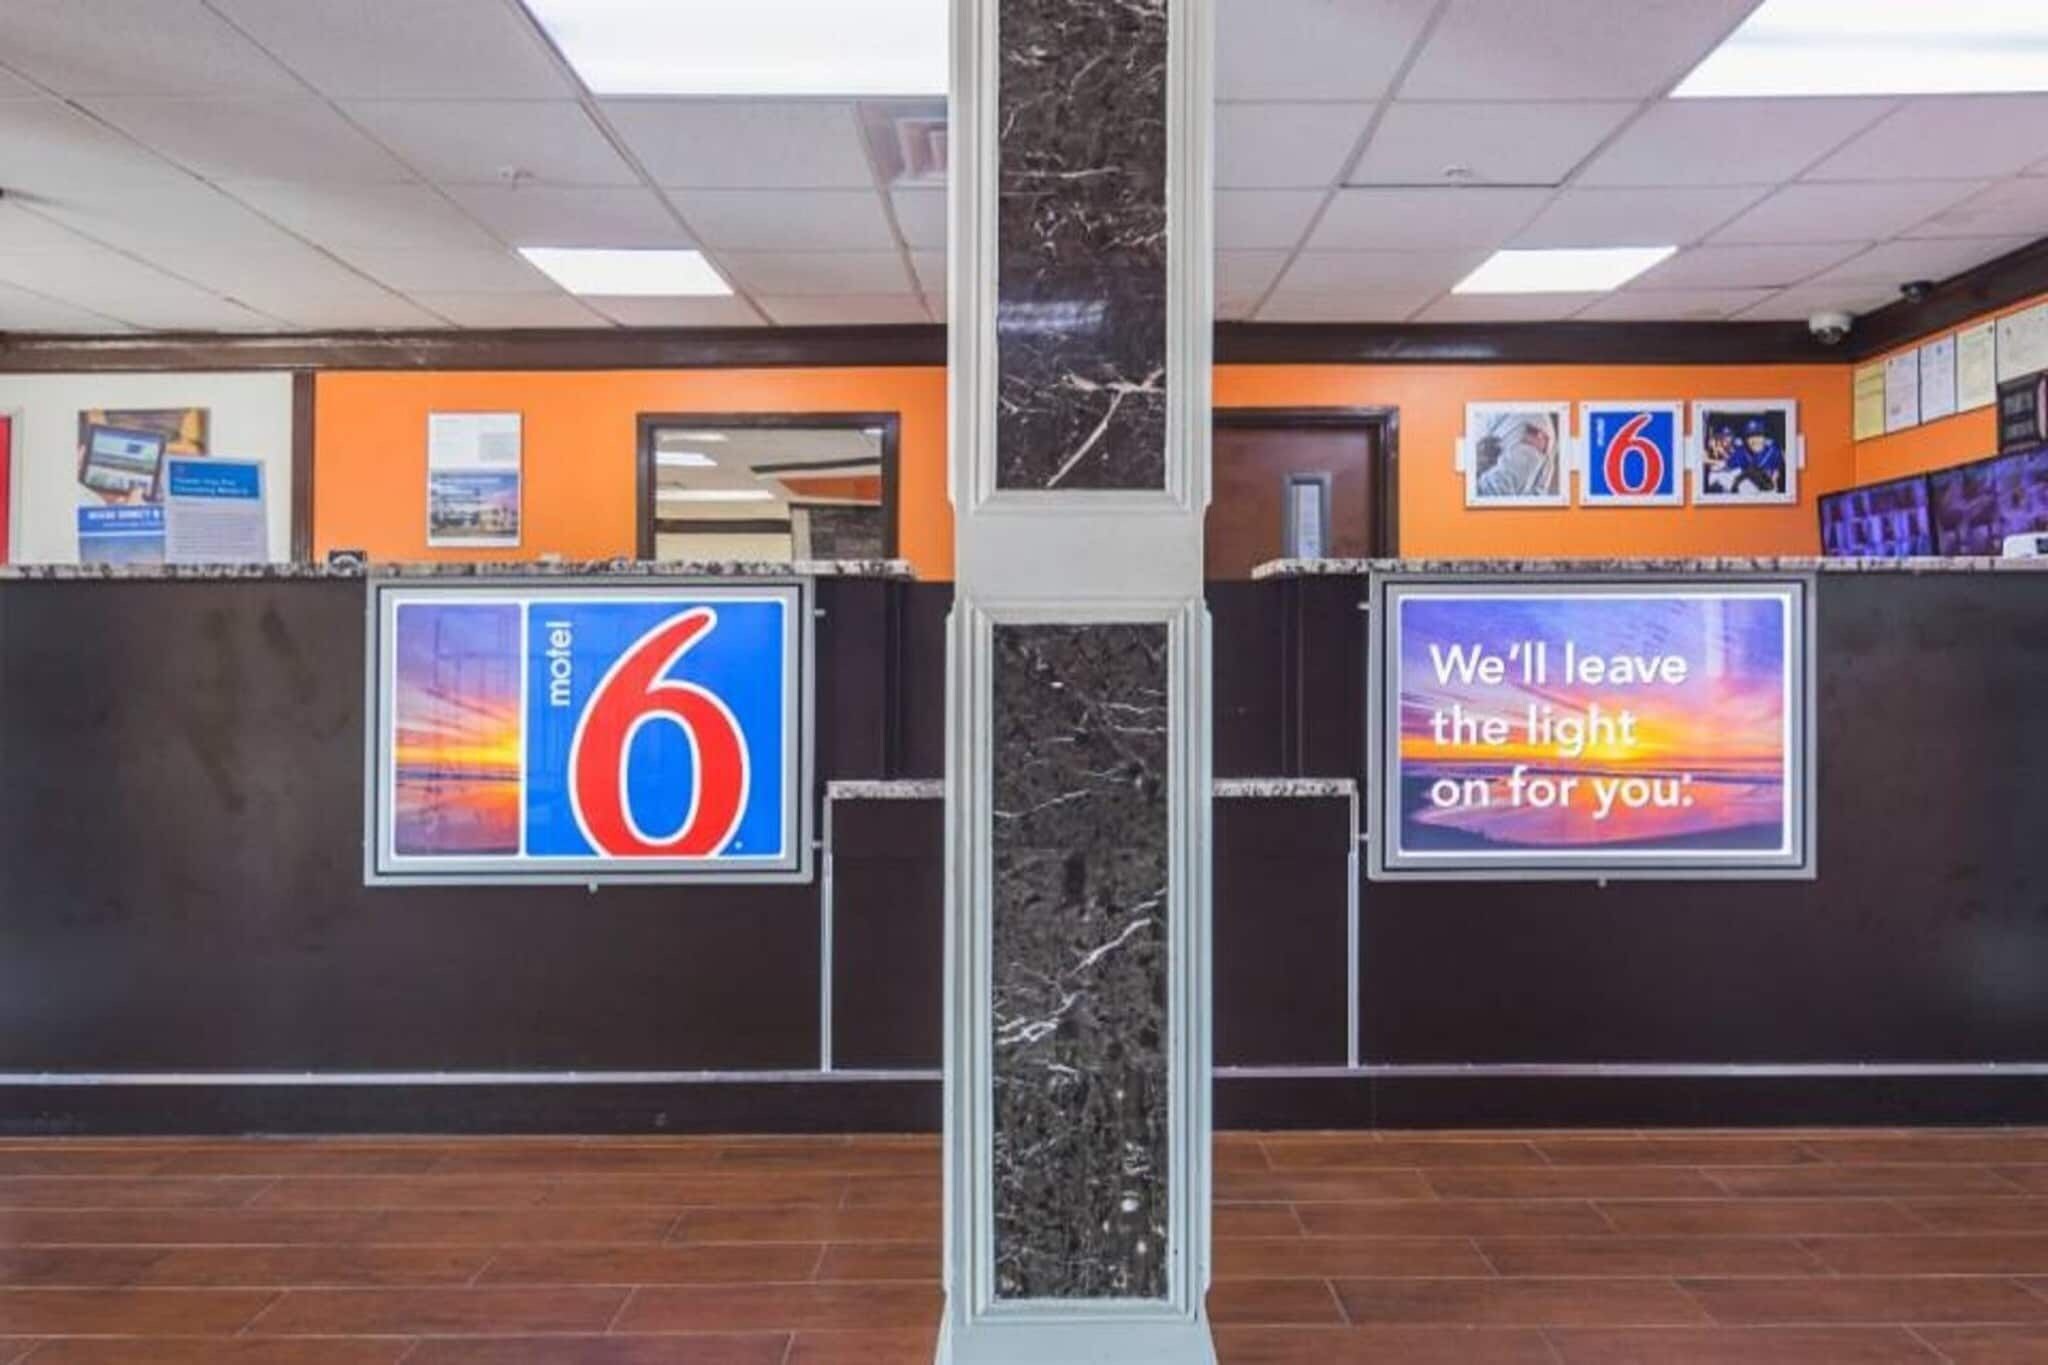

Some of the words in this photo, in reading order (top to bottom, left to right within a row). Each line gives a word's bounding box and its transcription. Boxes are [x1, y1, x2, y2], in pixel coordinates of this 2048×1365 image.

[1603, 413, 1664, 496] 6
[1429, 642, 1545, 684] We'll
[1566, 642, 1688, 684] leave
[546, 621, 573, 707] motel
[568, 606, 751, 859] 6
[1429, 704, 1511, 745] the
[1528, 704, 1638, 757] light
[1430, 778, 1490, 807] on
[1510, 765, 1579, 807] for
